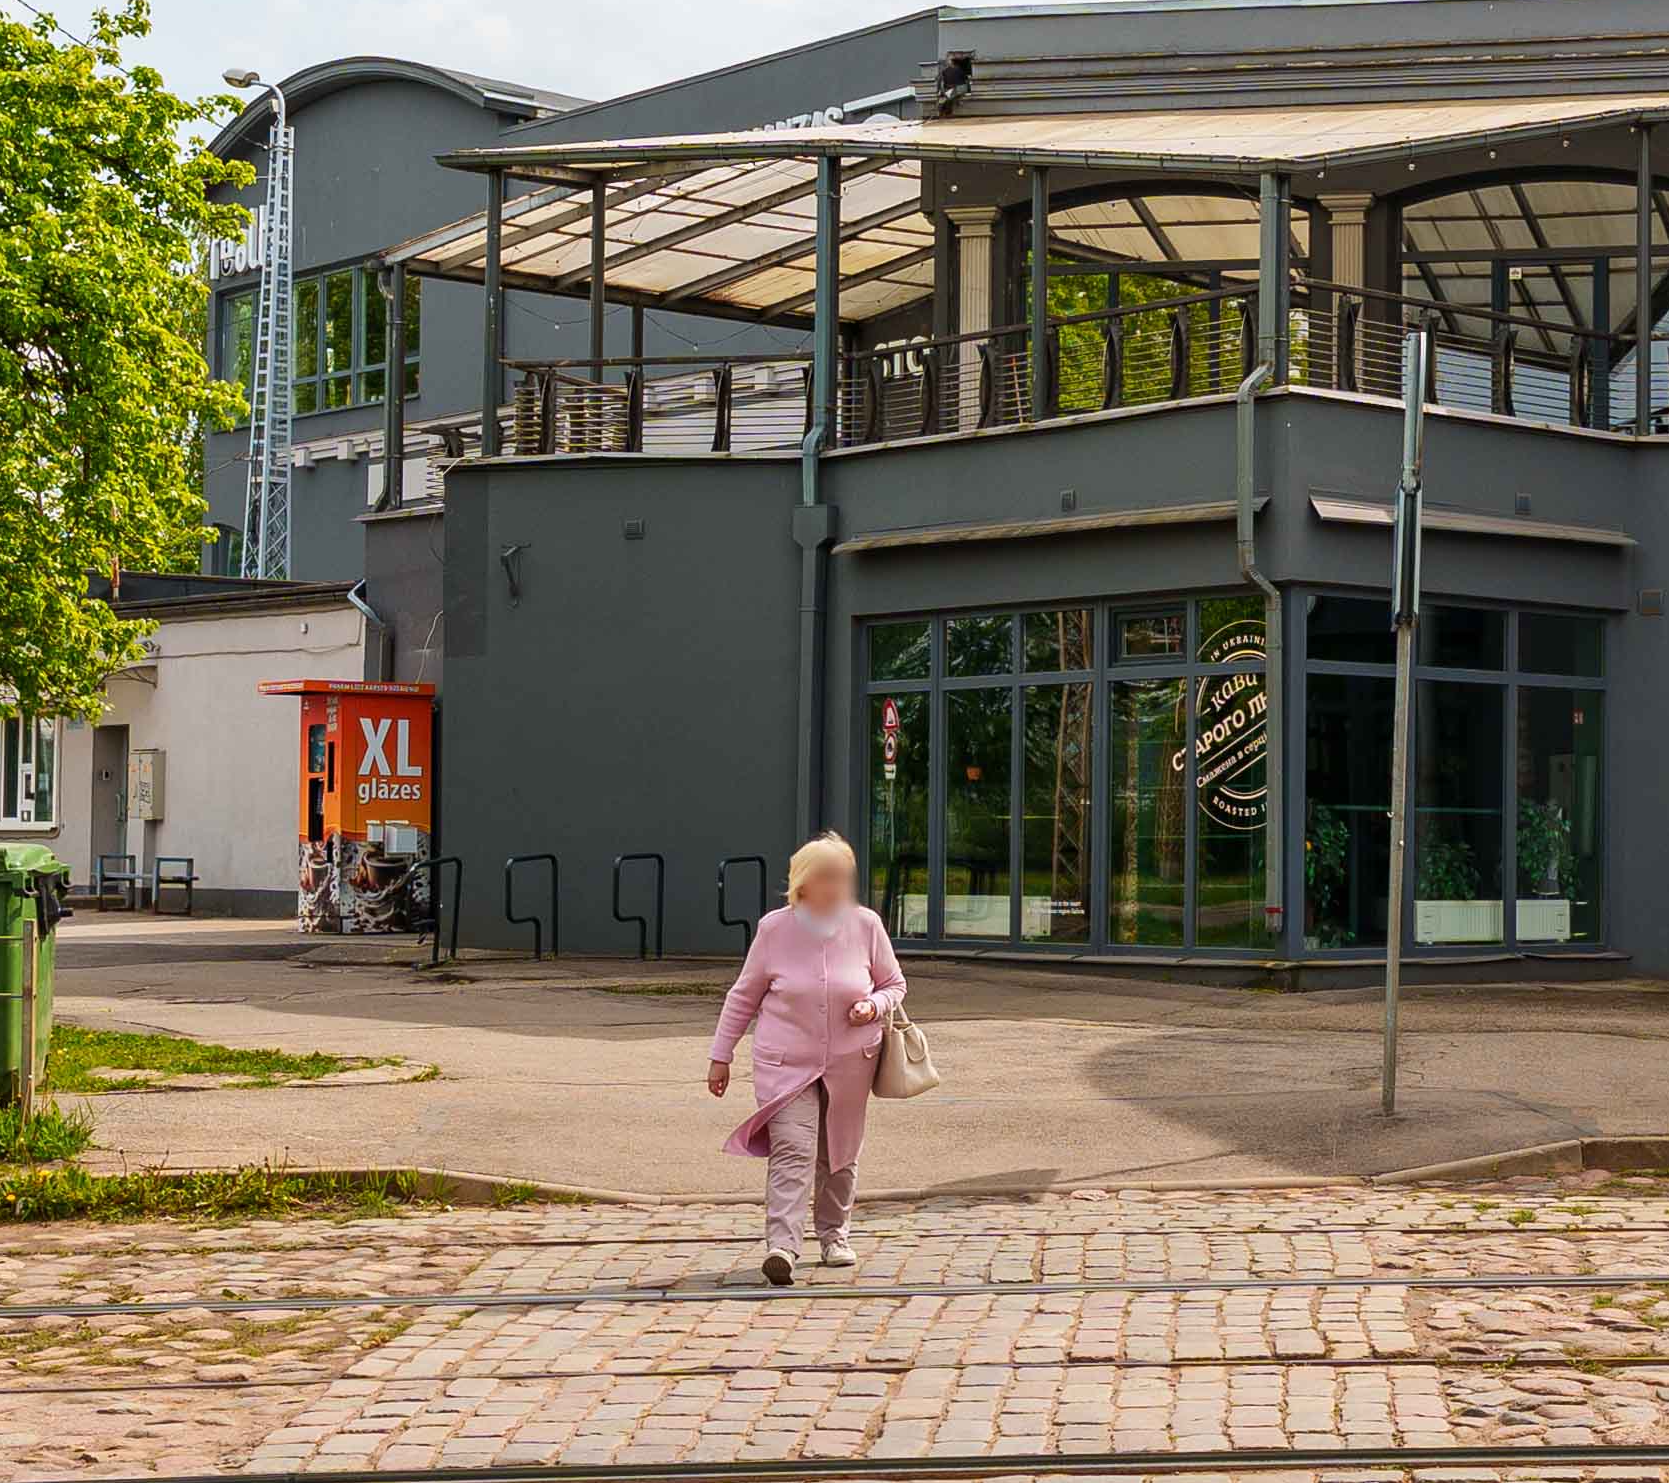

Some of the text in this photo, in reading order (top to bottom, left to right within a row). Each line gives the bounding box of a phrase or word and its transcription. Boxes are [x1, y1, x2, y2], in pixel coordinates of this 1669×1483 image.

[358, 718, 422, 776] XL
[358, 777, 421, 805] glāzes
[1213, 796, 1257, 817] ROASTED
